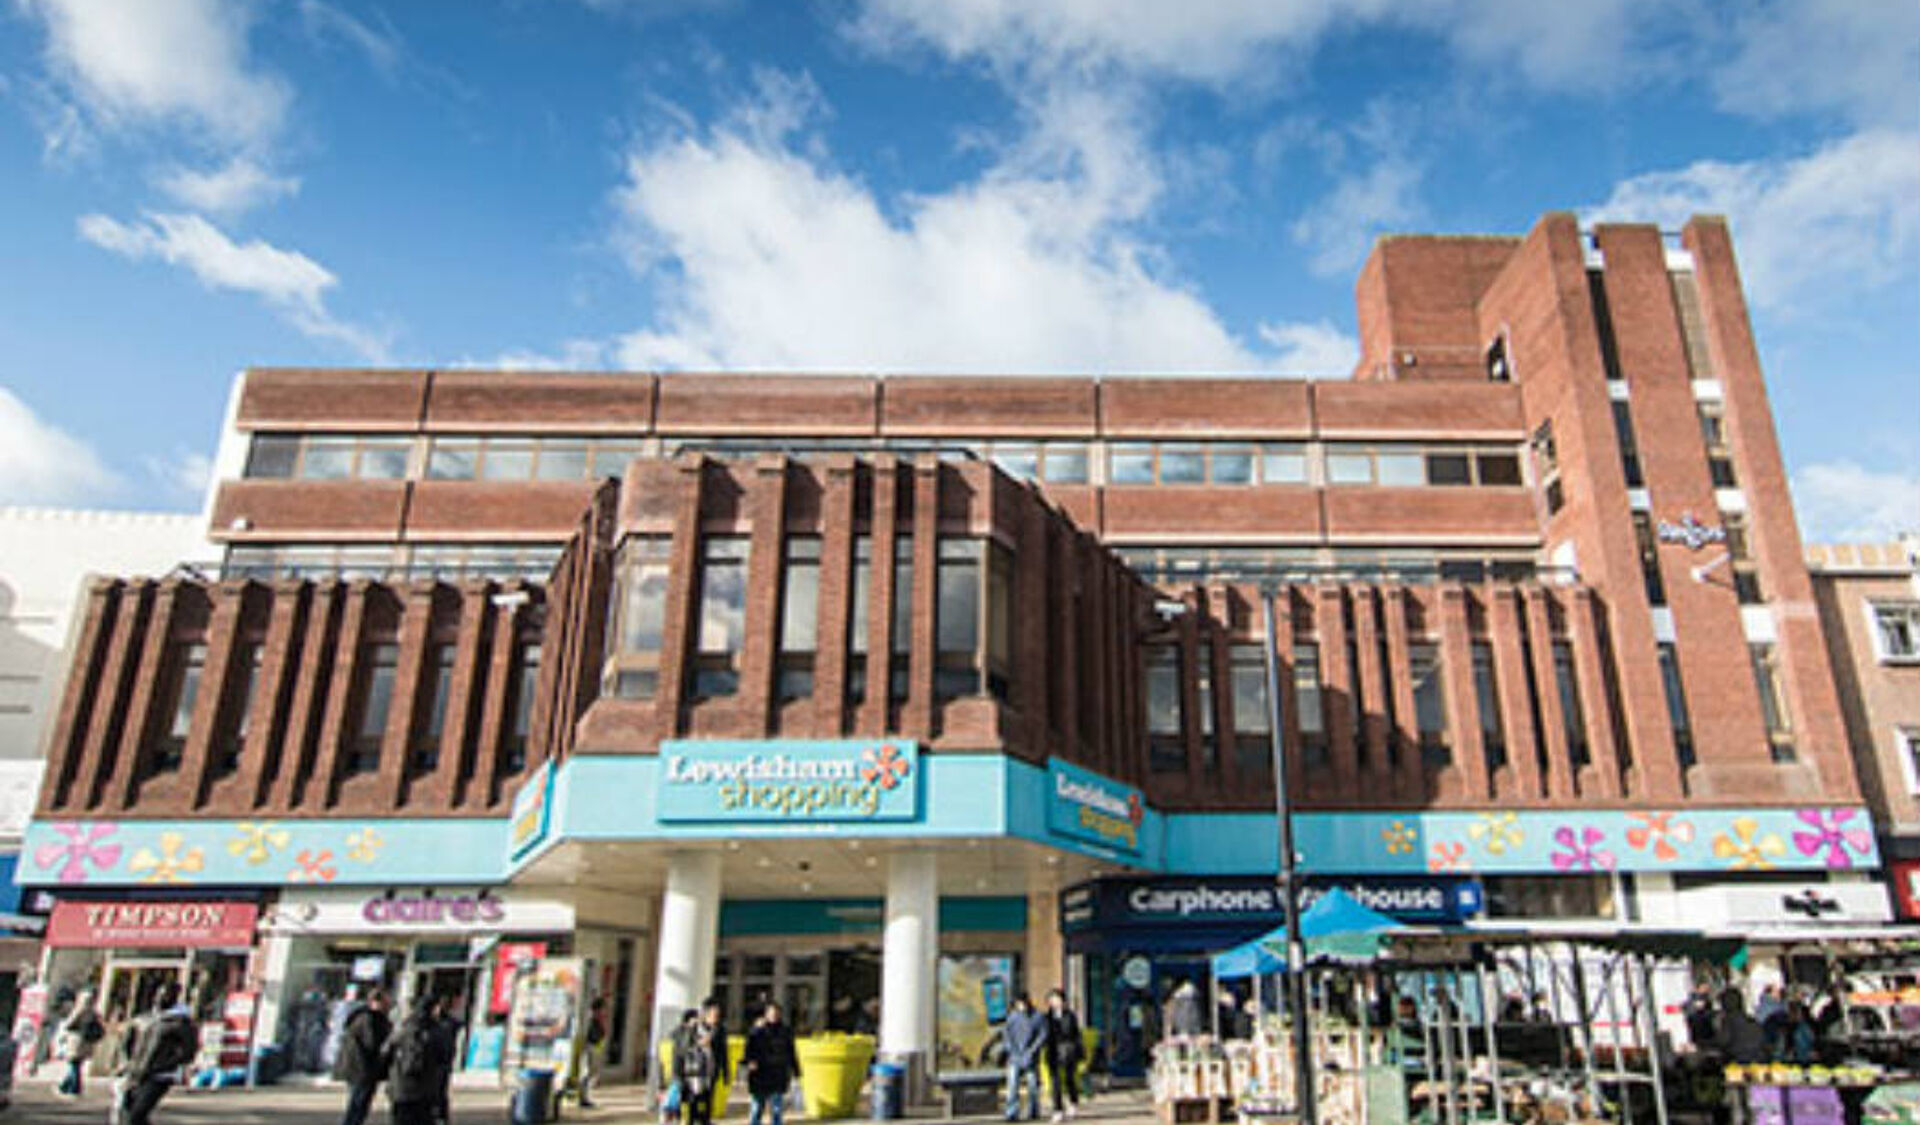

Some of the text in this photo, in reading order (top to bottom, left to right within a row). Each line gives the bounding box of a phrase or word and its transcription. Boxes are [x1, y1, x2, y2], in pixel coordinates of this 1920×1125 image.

[664, 753, 856, 784] Lewisham
[718, 776, 879, 815] shopping
[86, 903, 226, 927] TIMPSON
[1129, 884, 1273, 915] Carphone
